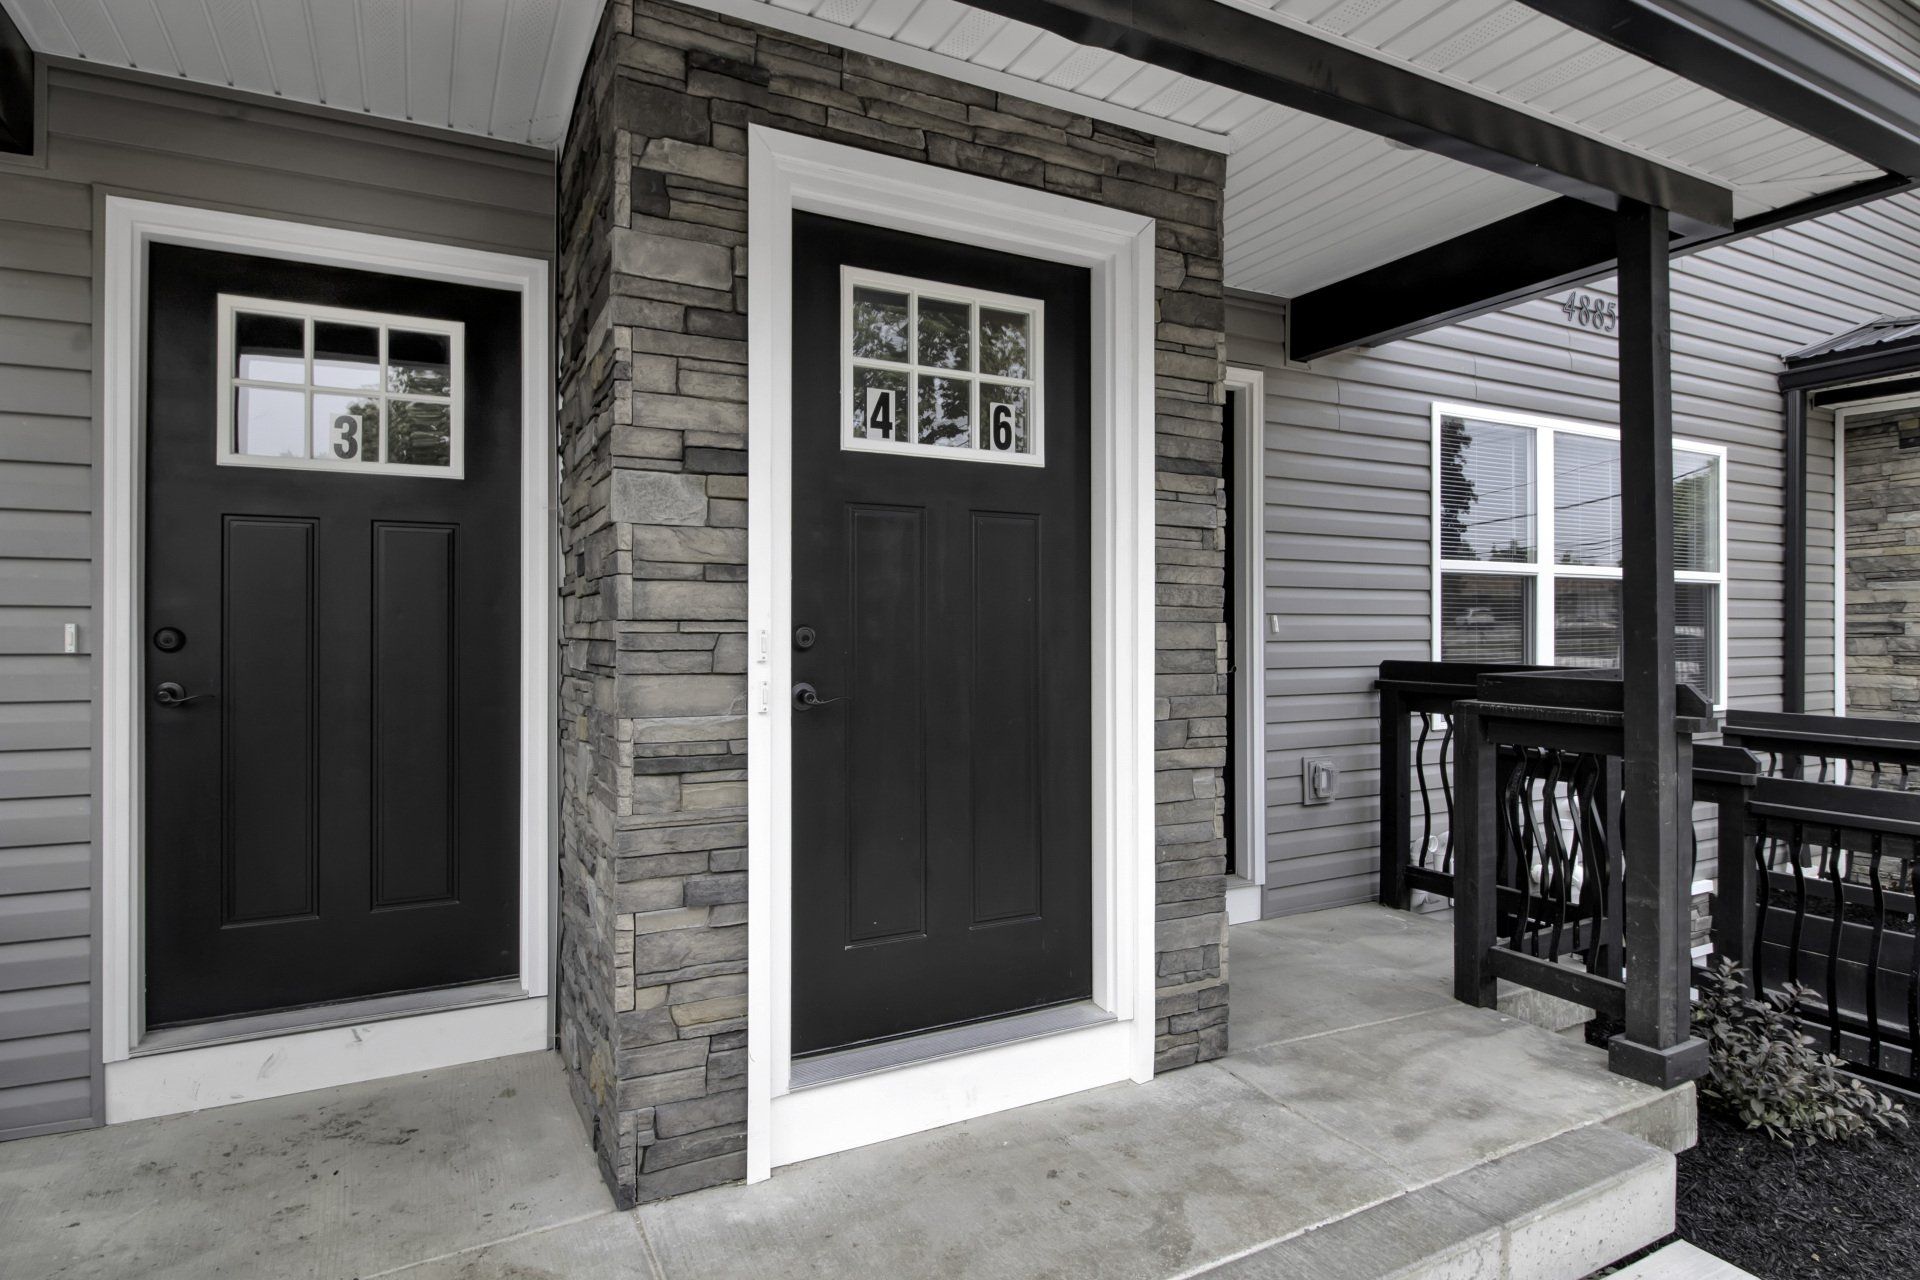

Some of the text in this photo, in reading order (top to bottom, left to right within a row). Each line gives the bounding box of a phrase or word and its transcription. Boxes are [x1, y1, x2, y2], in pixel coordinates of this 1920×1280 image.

[1562, 291, 1616, 332] 4885
[333, 415, 359, 459] 3
[870, 391, 893, 439] 4
[993, 404, 1013, 451] 6
